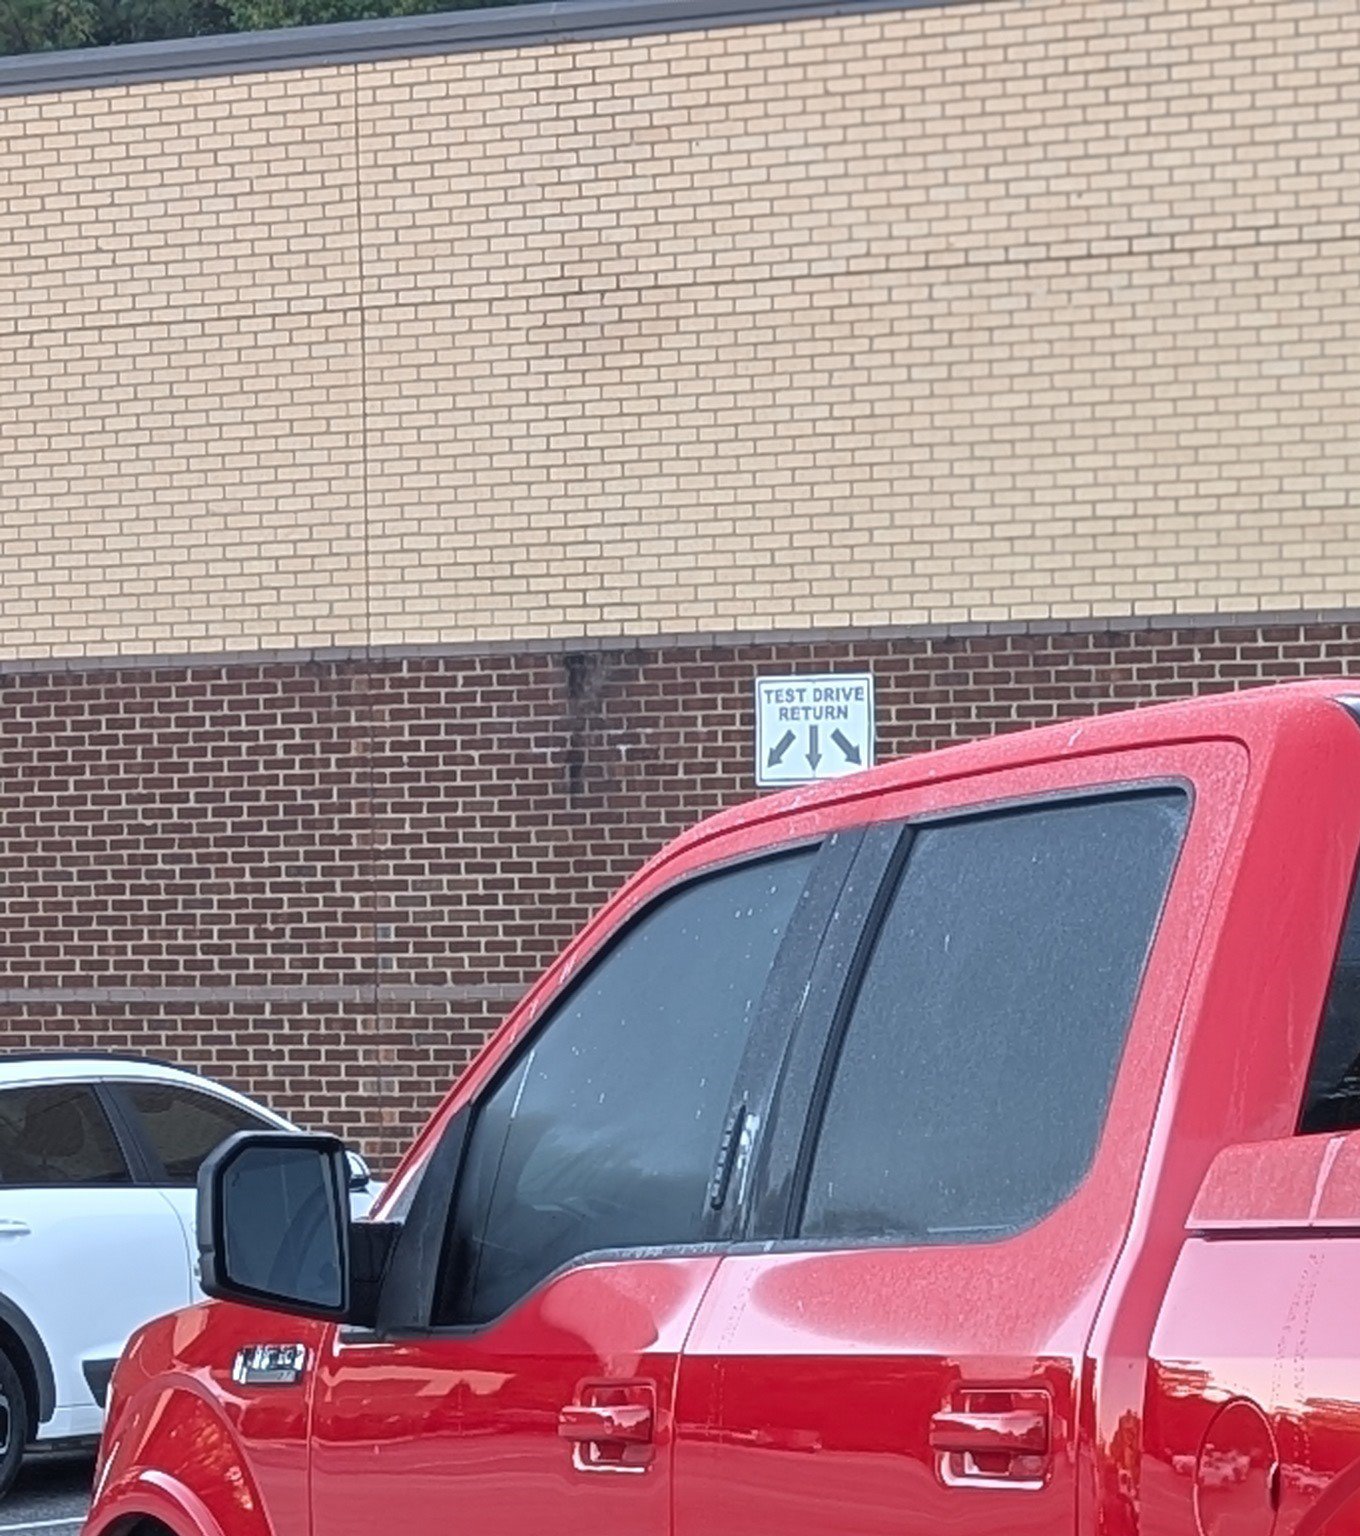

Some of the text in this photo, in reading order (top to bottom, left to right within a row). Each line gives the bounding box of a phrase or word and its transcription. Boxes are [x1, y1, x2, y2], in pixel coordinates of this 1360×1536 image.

[764, 686, 865, 704] TEST DRIVE
[778, 705, 848, 721] RETURN
